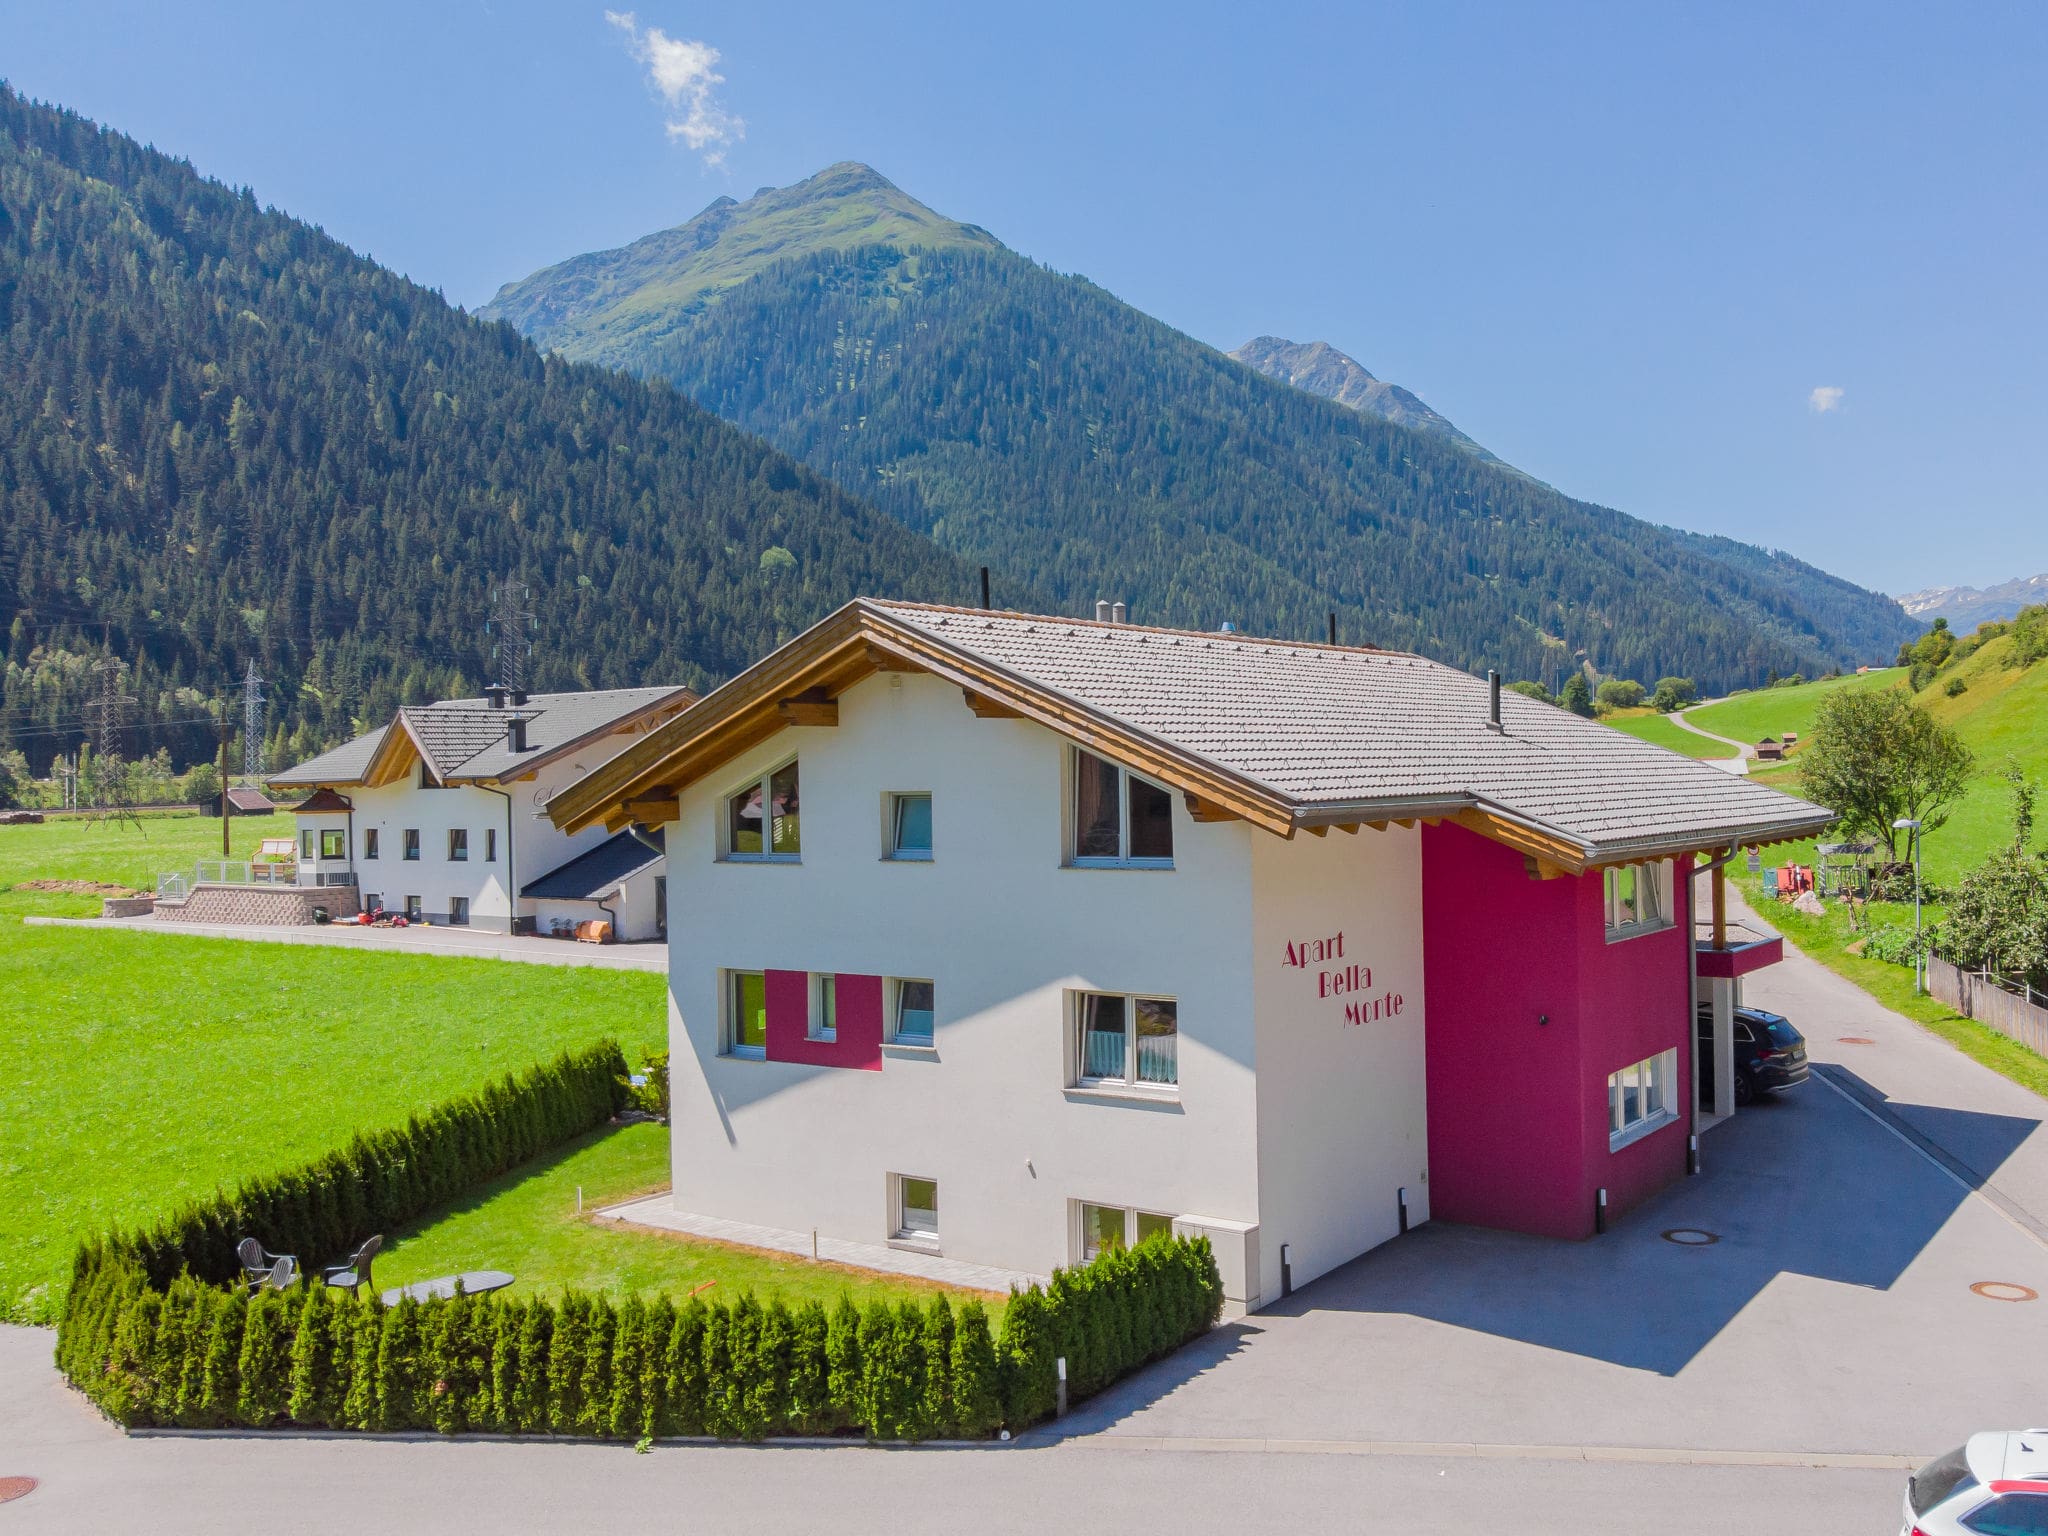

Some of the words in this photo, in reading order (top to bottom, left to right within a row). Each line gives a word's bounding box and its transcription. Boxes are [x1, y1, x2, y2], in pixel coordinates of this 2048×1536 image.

[1282, 930, 1345, 969] Apart
[1318, 964, 1372, 998] Bella
[1343, 991, 1404, 1029] Monte
